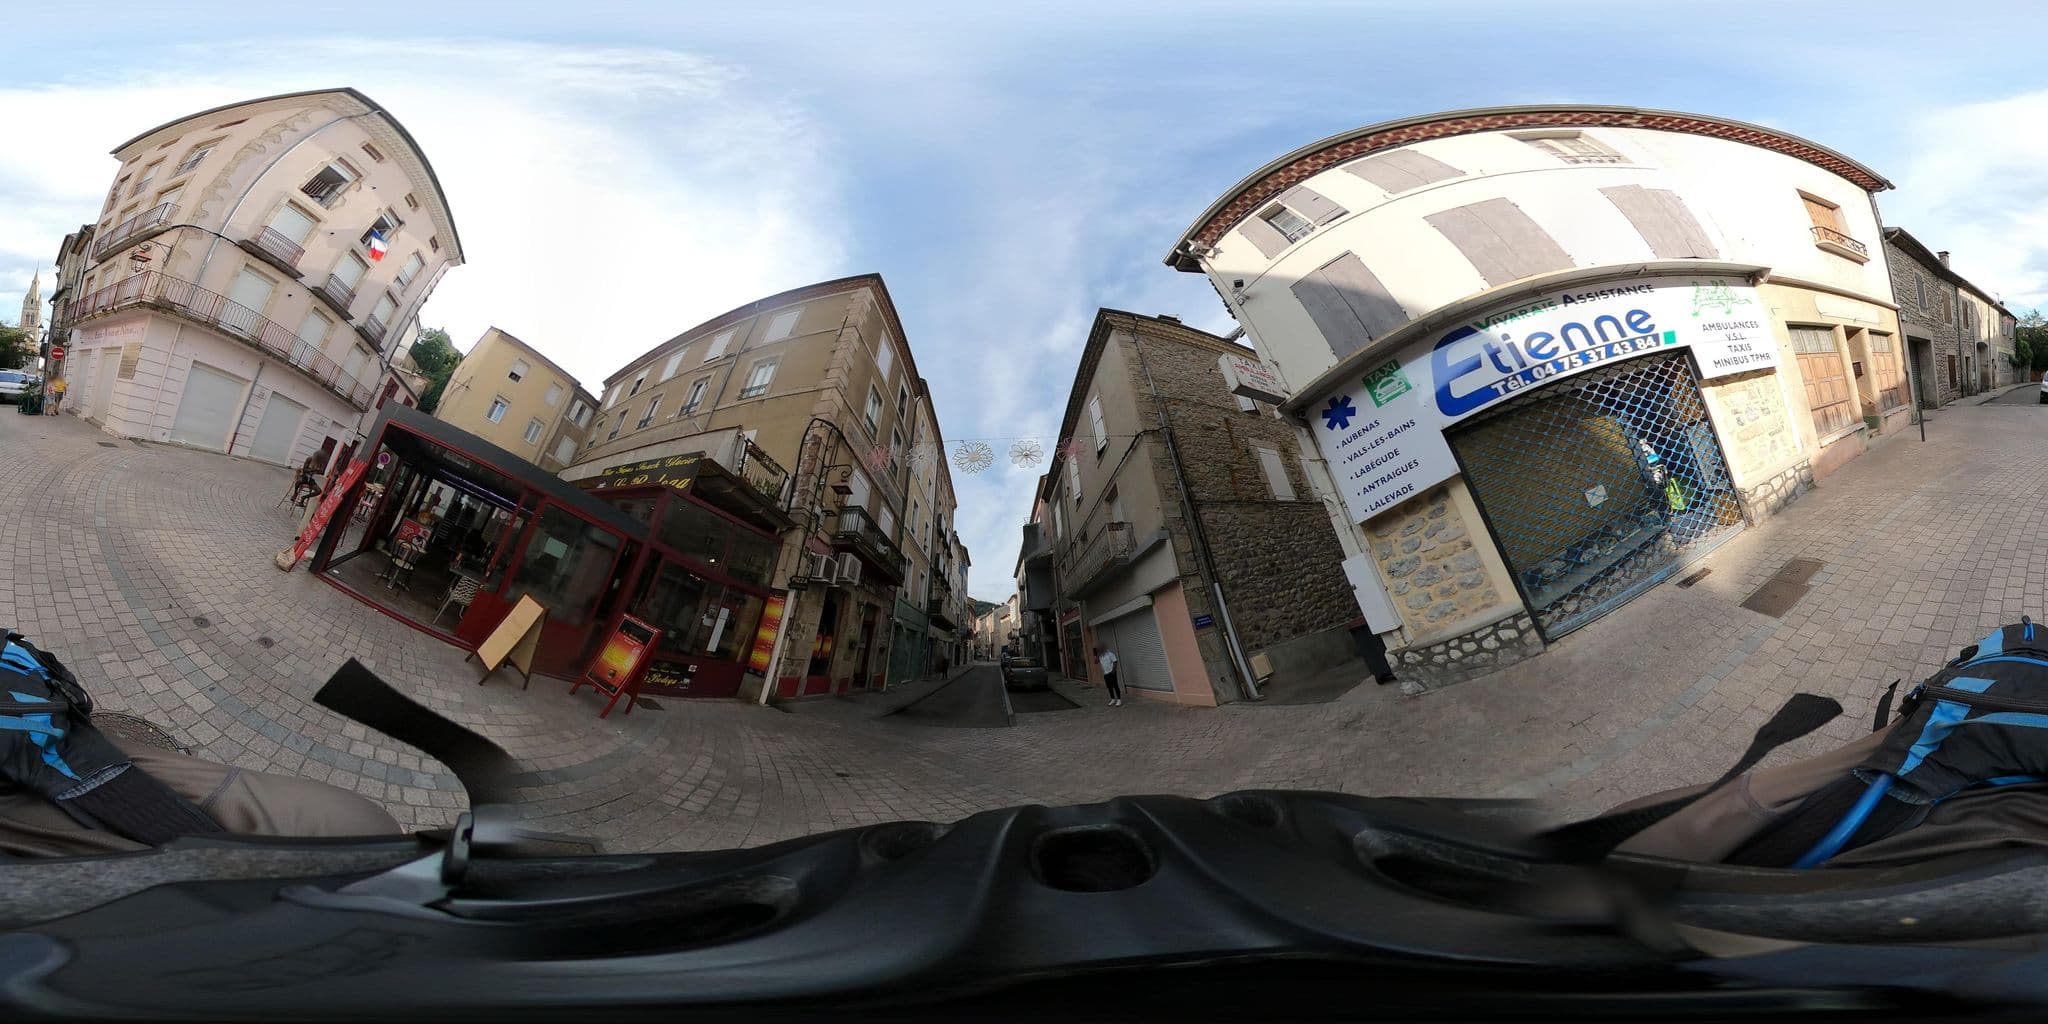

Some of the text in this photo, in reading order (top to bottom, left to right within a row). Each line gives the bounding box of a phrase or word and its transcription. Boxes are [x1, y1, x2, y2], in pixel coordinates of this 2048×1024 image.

[1472, 283, 1655, 332] VIVARAIS ASSISTANCE
[1702, 320, 1759, 332] AMBULANCES
[1725, 332, 1747, 341] V.S.L.
[1431, 308, 1656, 417] Etienne
[1713, 352, 1771, 368] MINIBUS TPMR
[1727, 343, 1752, 353] TAXIS
[1366, 361, 1397, 384] TAXI
[1490, 334, 1657, 397] Tél. 04 75 37 43 84
[1341, 419, 1381, 448] AUBENAS
[1347, 419, 1416, 462] VALS-LES-BAINS
[1362, 459, 1420, 495] ANTRAIGUES
[1369, 483, 1415, 512] LALEVADE
